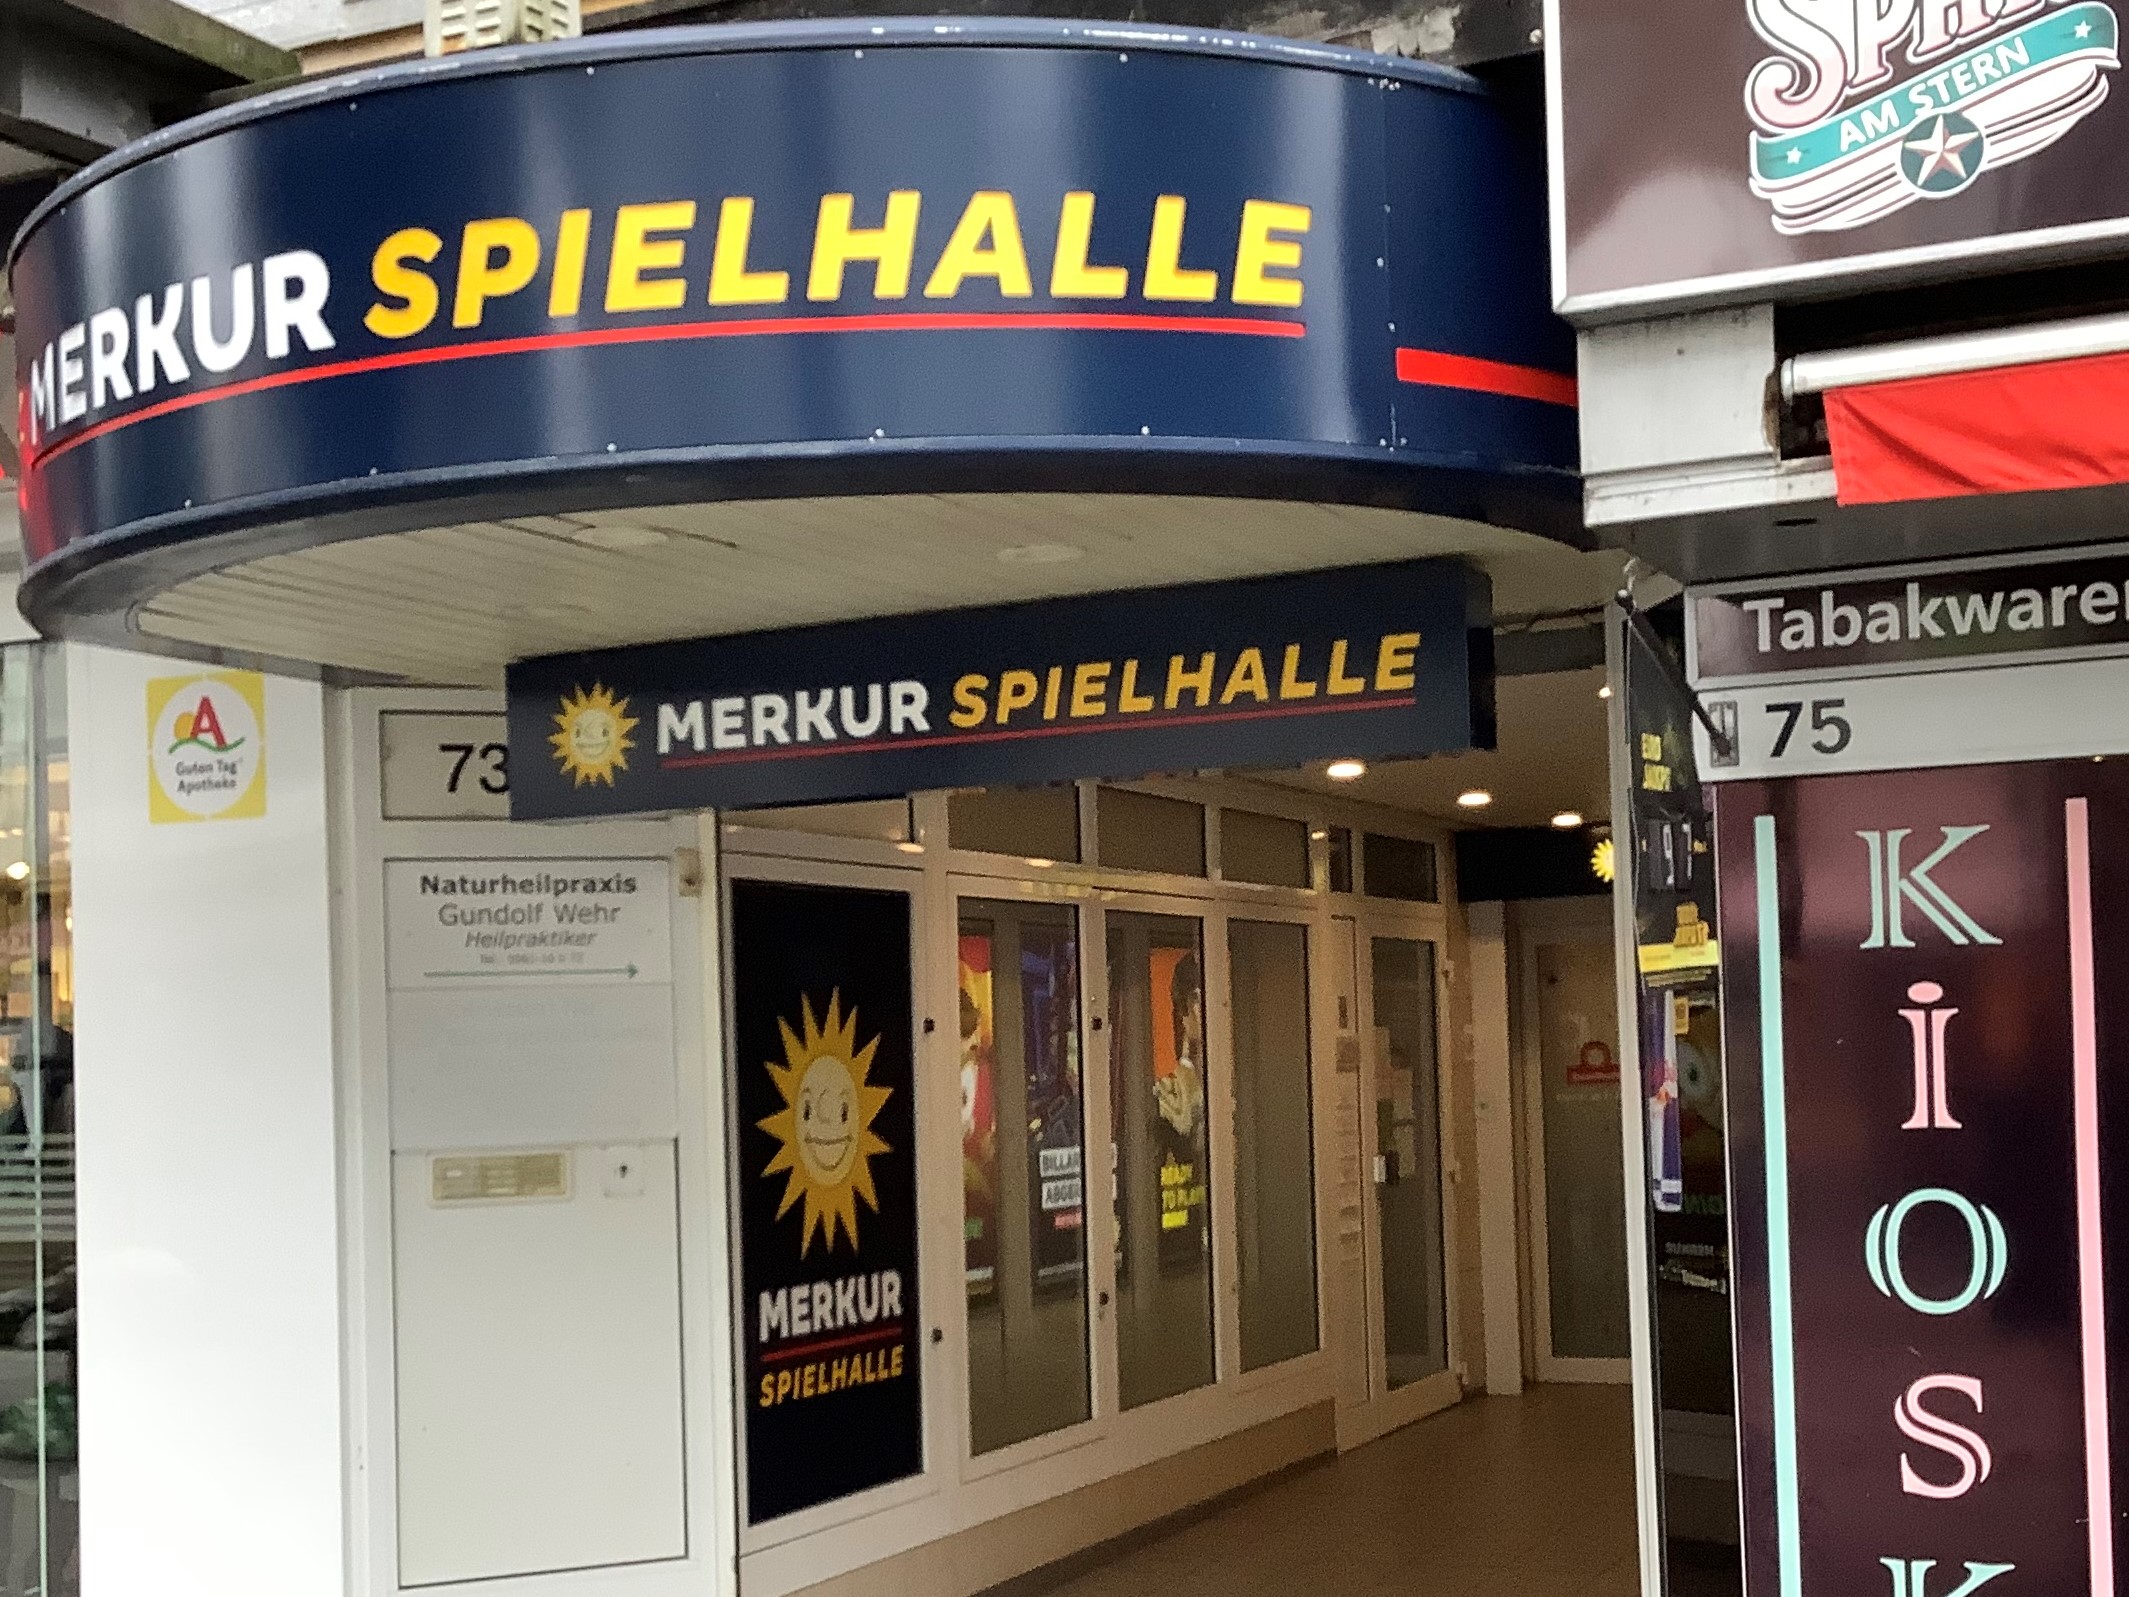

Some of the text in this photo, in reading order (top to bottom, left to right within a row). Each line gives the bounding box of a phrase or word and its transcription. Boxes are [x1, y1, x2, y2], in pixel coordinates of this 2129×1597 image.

[1840, 36, 2031, 153] AM STERN
[30, 190, 1312, 444] MERKUR SPIELHALLE
[1743, 580, 2129, 653] Tabakware
[656, 632, 1422, 755] MERKUR SPIELHALLE
[1765, 698, 1852, 758] 75
[438, 742, 510, 794] 73
[420, 873, 637, 898] Naturheilpraxis
[438, 902, 621, 927] Gundolf Wehr
[465, 930, 598, 950] Heilpraktiker
[758, 1269, 903, 1344] MERKUR
[759, 1343, 904, 1408] SPIELHALLE
